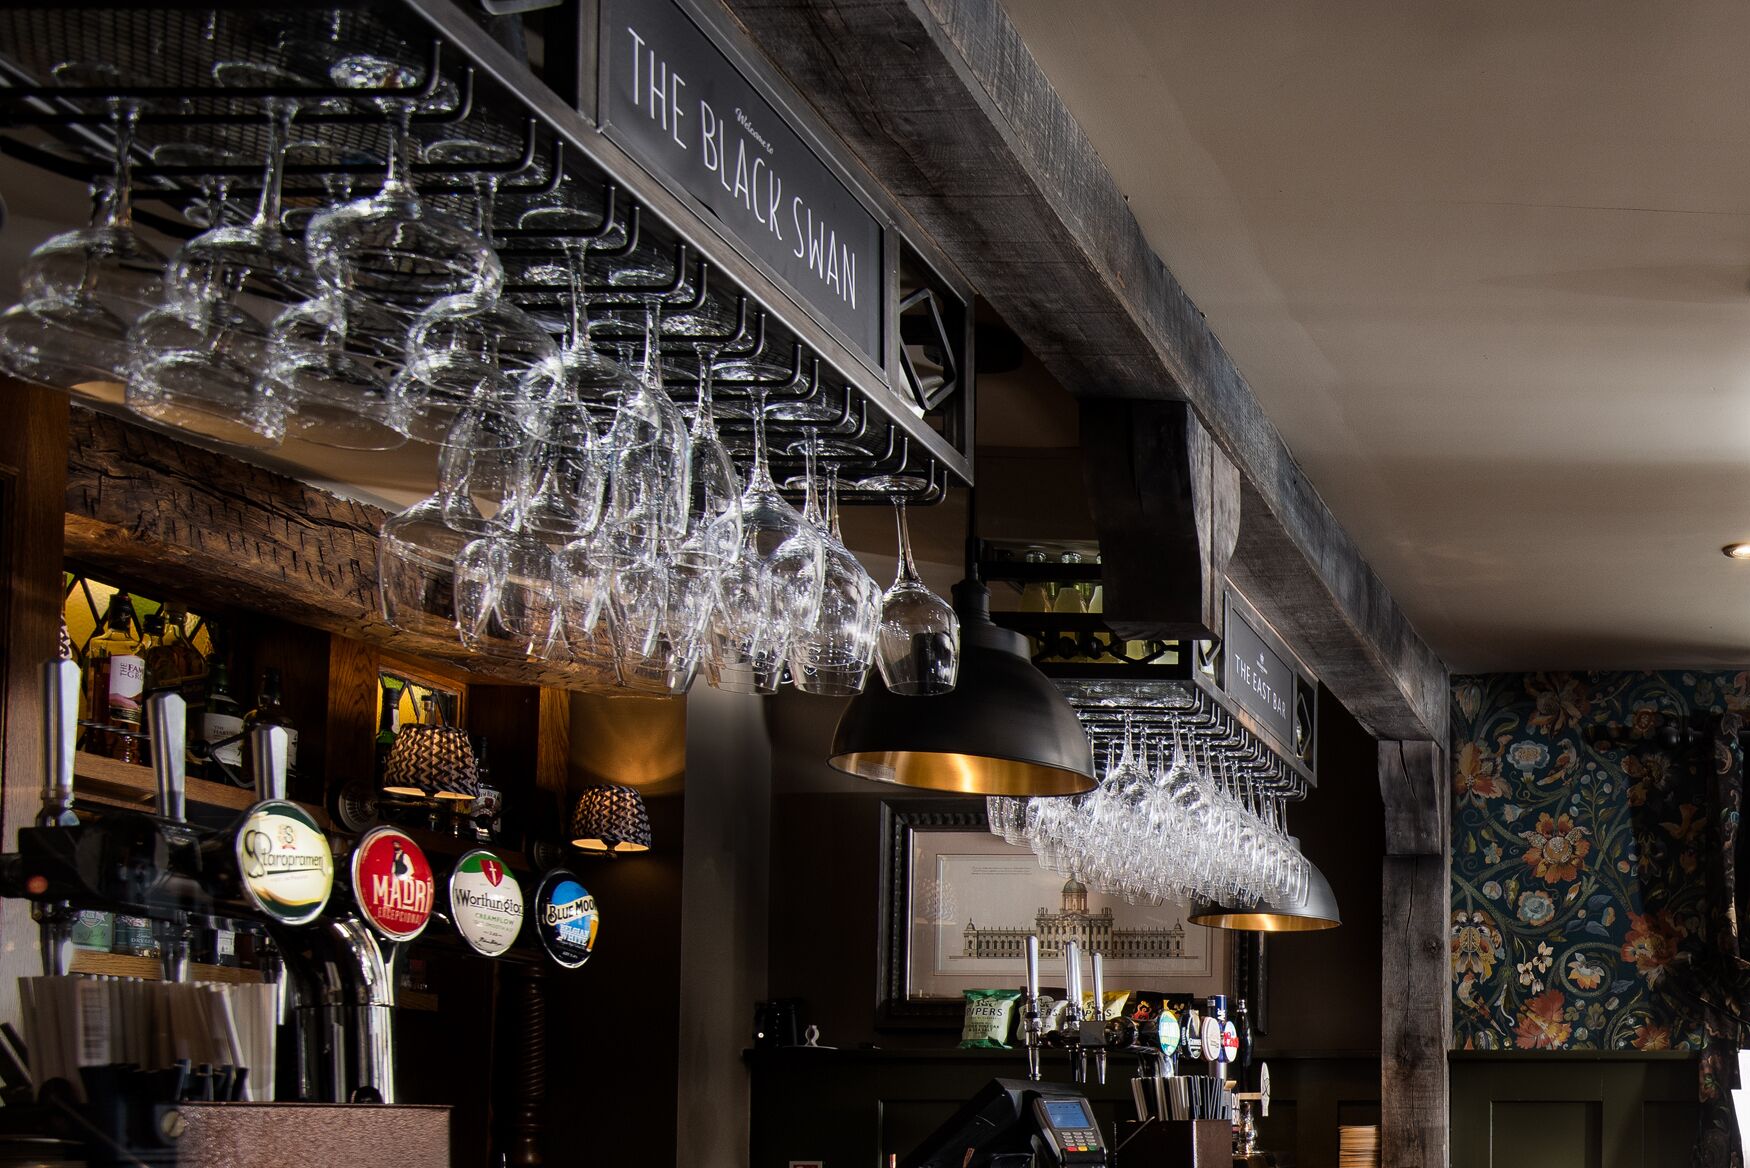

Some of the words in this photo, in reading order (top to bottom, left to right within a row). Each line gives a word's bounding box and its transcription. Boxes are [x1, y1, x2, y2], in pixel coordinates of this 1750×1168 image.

[735, 107, 766, 147] Welcome
[628, 27, 687, 150] THE
[700, 99, 783, 241] BLACK
[792, 196, 858, 310] SWAN
[1235, 654, 1250, 685] THE
[1253, 671, 1271, 703] EAST
[1273, 692, 1286, 719] BAR
[245, 829, 324, 878] Staropramen
[547, 904, 574, 923] BLUE
[966, 1007, 1003, 1017] PIPERS
